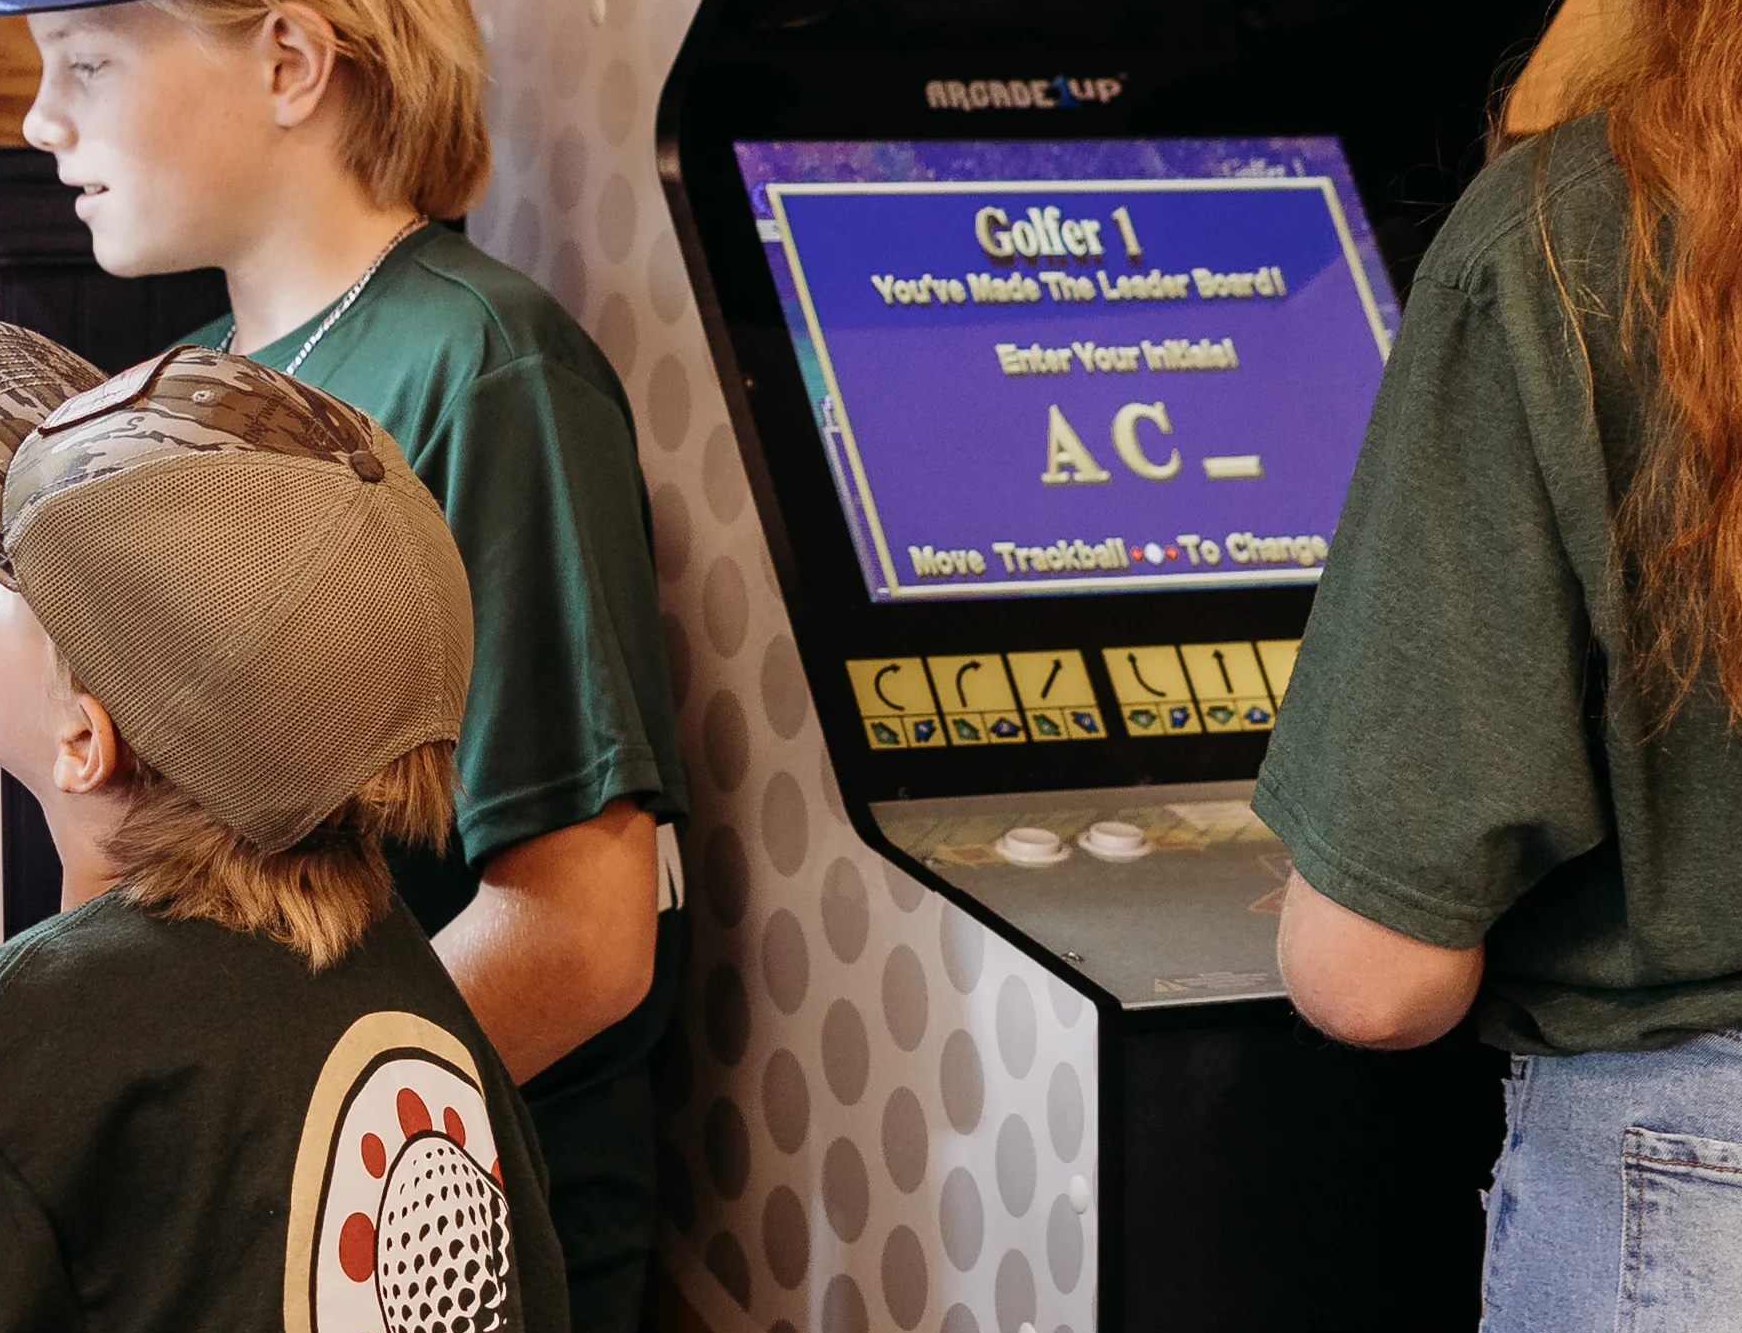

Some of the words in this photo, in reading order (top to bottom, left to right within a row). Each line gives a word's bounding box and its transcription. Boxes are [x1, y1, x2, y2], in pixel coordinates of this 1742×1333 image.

[974, 204, 1106, 258] Golfer
[1111, 204, 1143, 258] 1
[871, 273, 965, 306] You've
[966, 271, 1041, 304] Made
[1039, 270, 1095, 302] The
[1096, 268, 1190, 301] Leader
[1191, 266, 1288, 299] Board!
[996, 342, 1073, 376] Enter
[1072, 340, 1140, 373] Your
[908, 543, 988, 578] Move
[990, 536, 1131, 574] Trackball
[1175, 533, 1222, 567] To
[1225, 531, 1330, 567] Change
